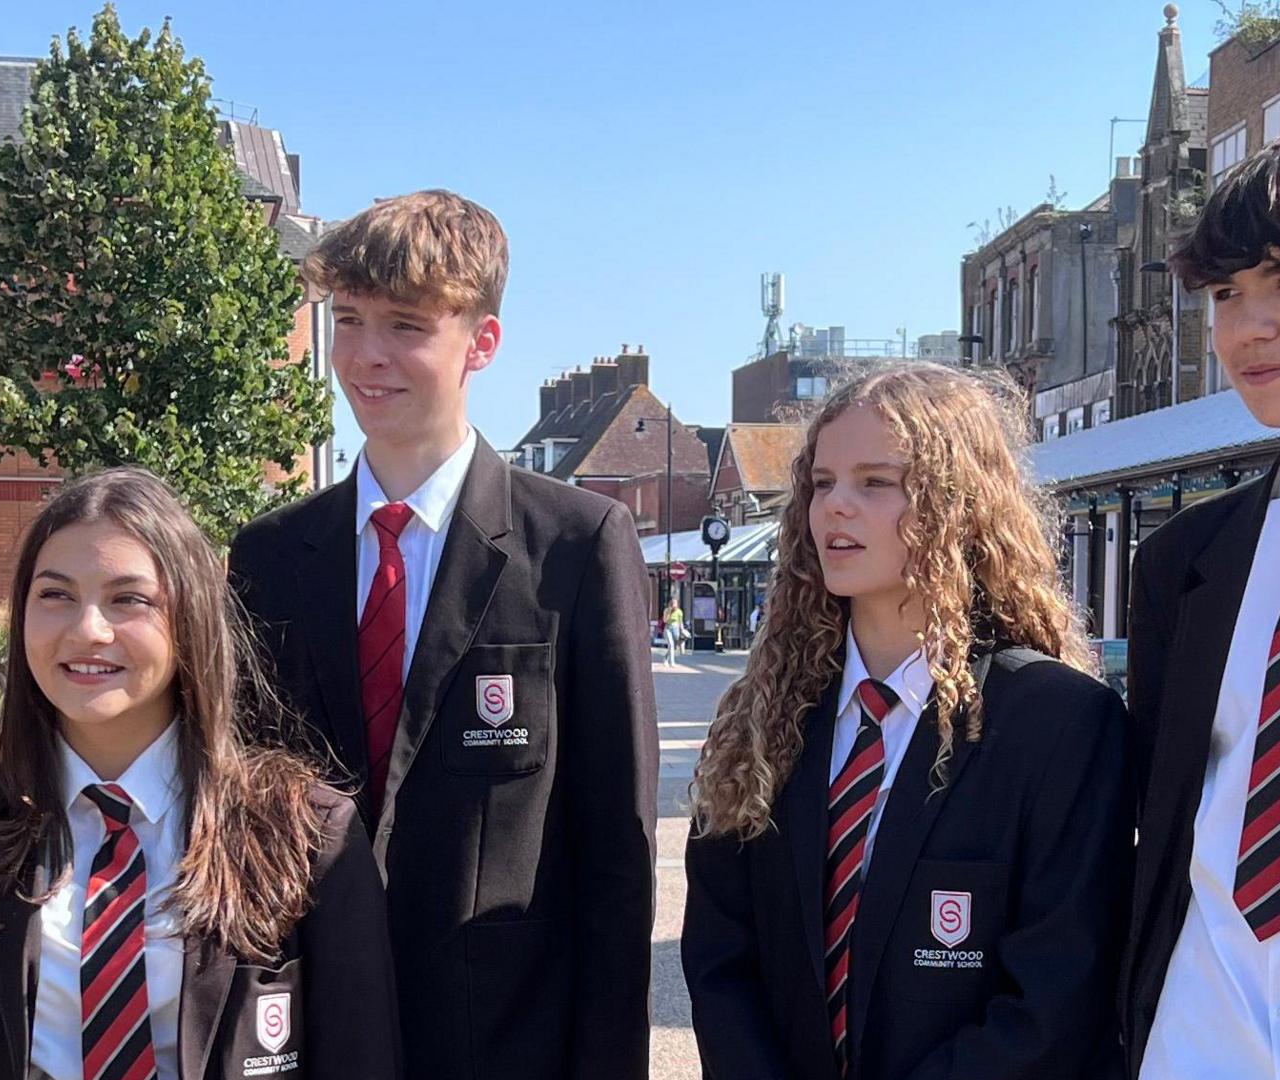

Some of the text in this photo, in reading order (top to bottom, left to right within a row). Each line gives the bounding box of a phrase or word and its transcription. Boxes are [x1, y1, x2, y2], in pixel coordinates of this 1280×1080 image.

[463, 728, 528, 739] CRESTWOOD
[463, 739, 501, 747] COMMUNITY
[914, 949, 983, 960] CRESTWOOD
[913, 959, 955, 968] COMMUNITY
[243, 1051, 298, 1068] CRESTWOOD
